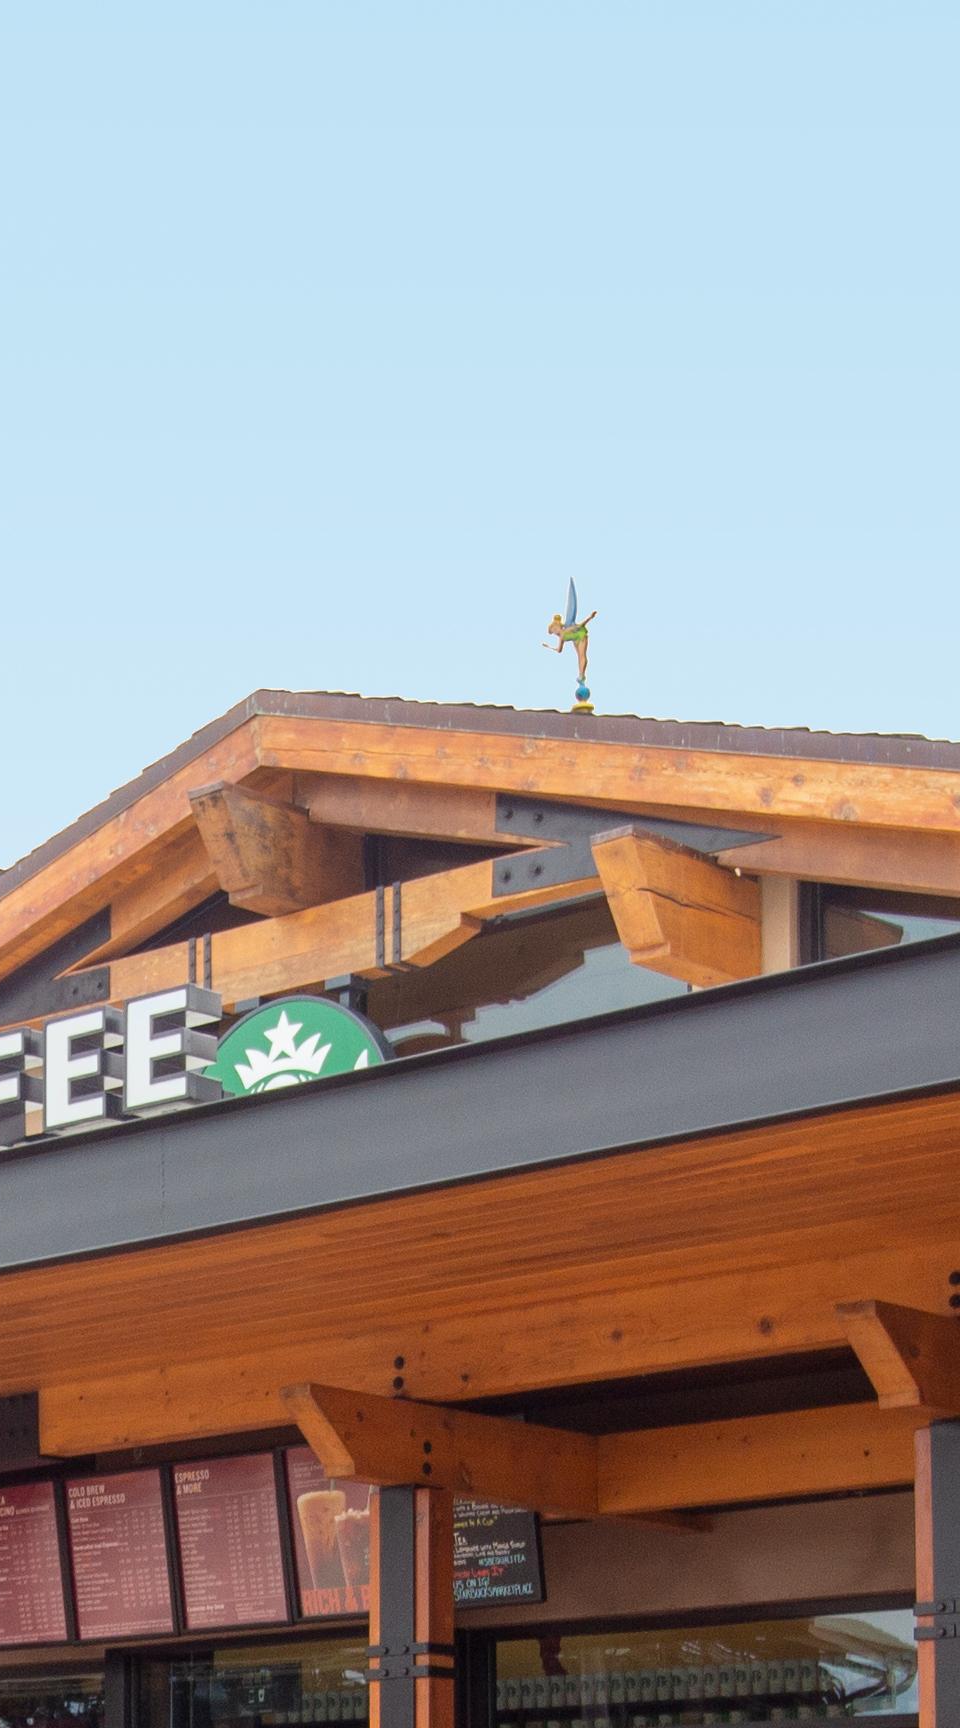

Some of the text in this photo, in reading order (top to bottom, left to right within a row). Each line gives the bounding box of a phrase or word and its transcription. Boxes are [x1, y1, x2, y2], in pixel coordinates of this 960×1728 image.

[174, 1469, 210, 1484] ESPRESSO
[68, 1485, 105, 1498] COLD BREW
[91, 1493, 126, 1507] ESPRESSO
